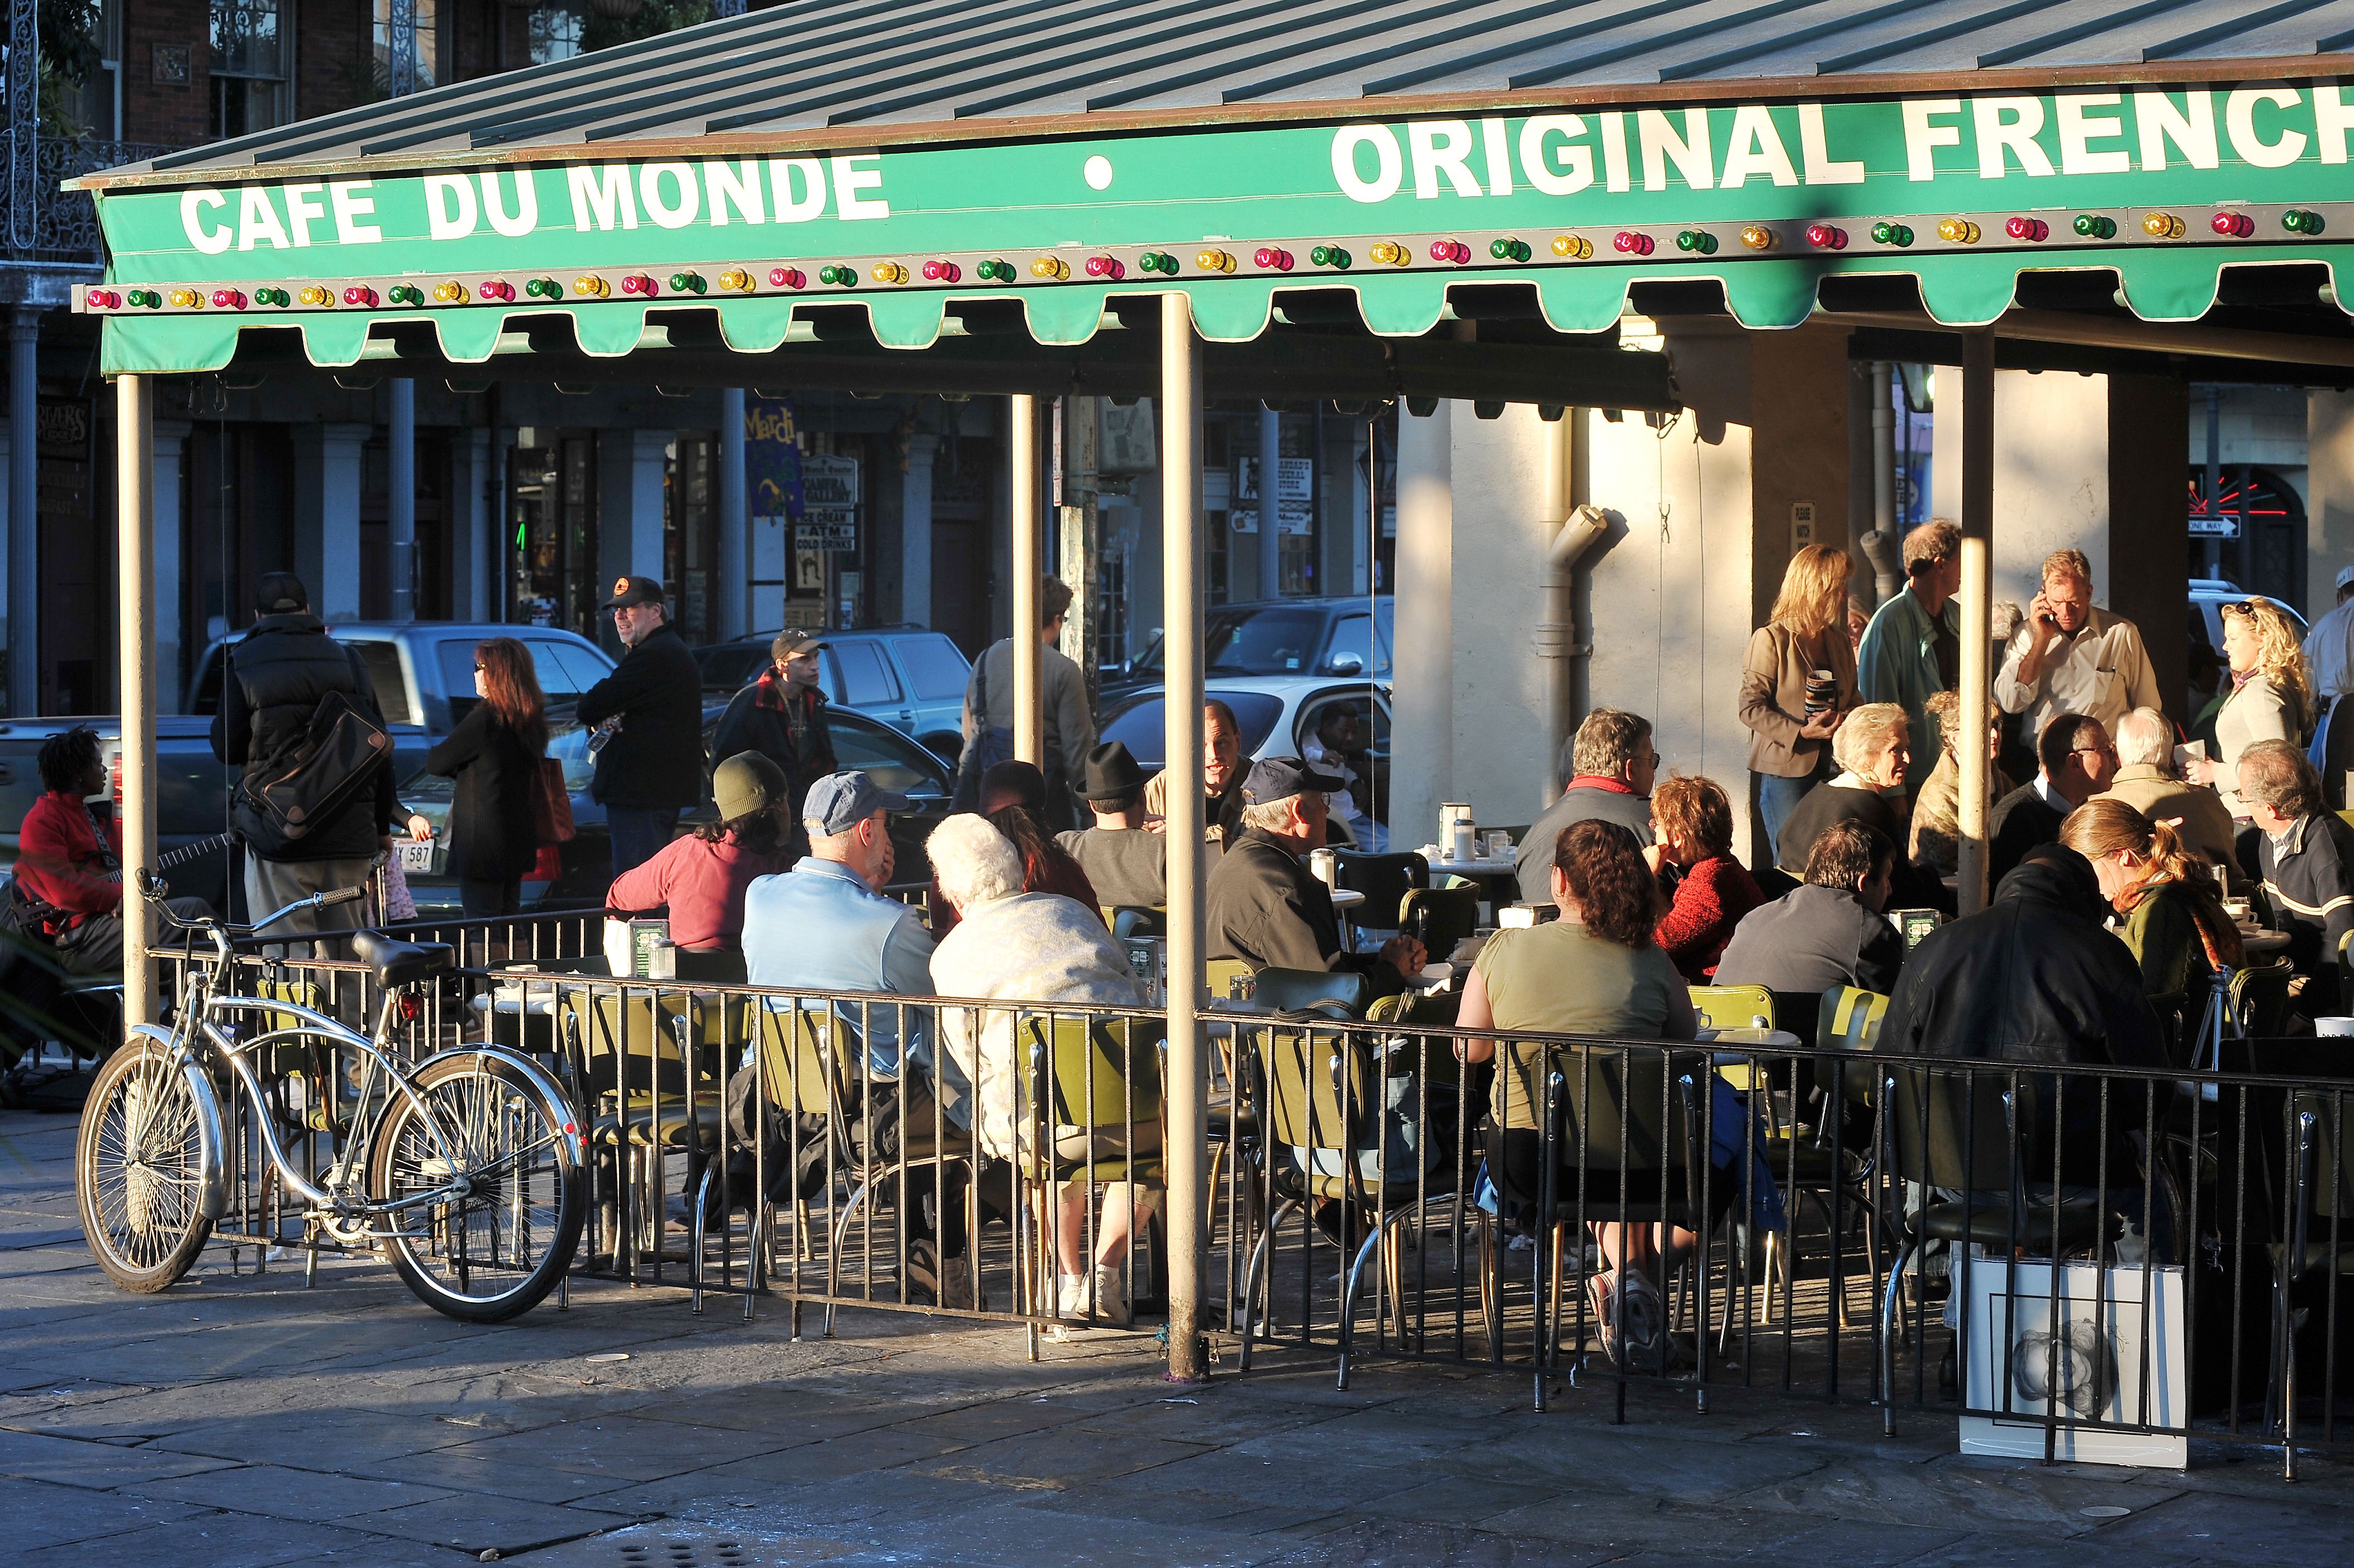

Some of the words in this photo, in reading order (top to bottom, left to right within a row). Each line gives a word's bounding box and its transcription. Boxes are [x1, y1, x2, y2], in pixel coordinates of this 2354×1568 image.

[180, 174, 383, 255] CAFE
[423, 161, 539, 241] DU
[565, 148, 890, 232] MONDE
[1331, 98, 1865, 203] ORIGINAL
[410, 288, 429, 304] 587
[745, 406, 795, 444] Mardi
[817, 512, 846, 522] CREAM
[1796, 507, 1810, 520] PLEASE
[809, 526, 840, 536] ATM
[797, 540, 819, 549] COLD
[822, 540, 853, 549] DRINKS
